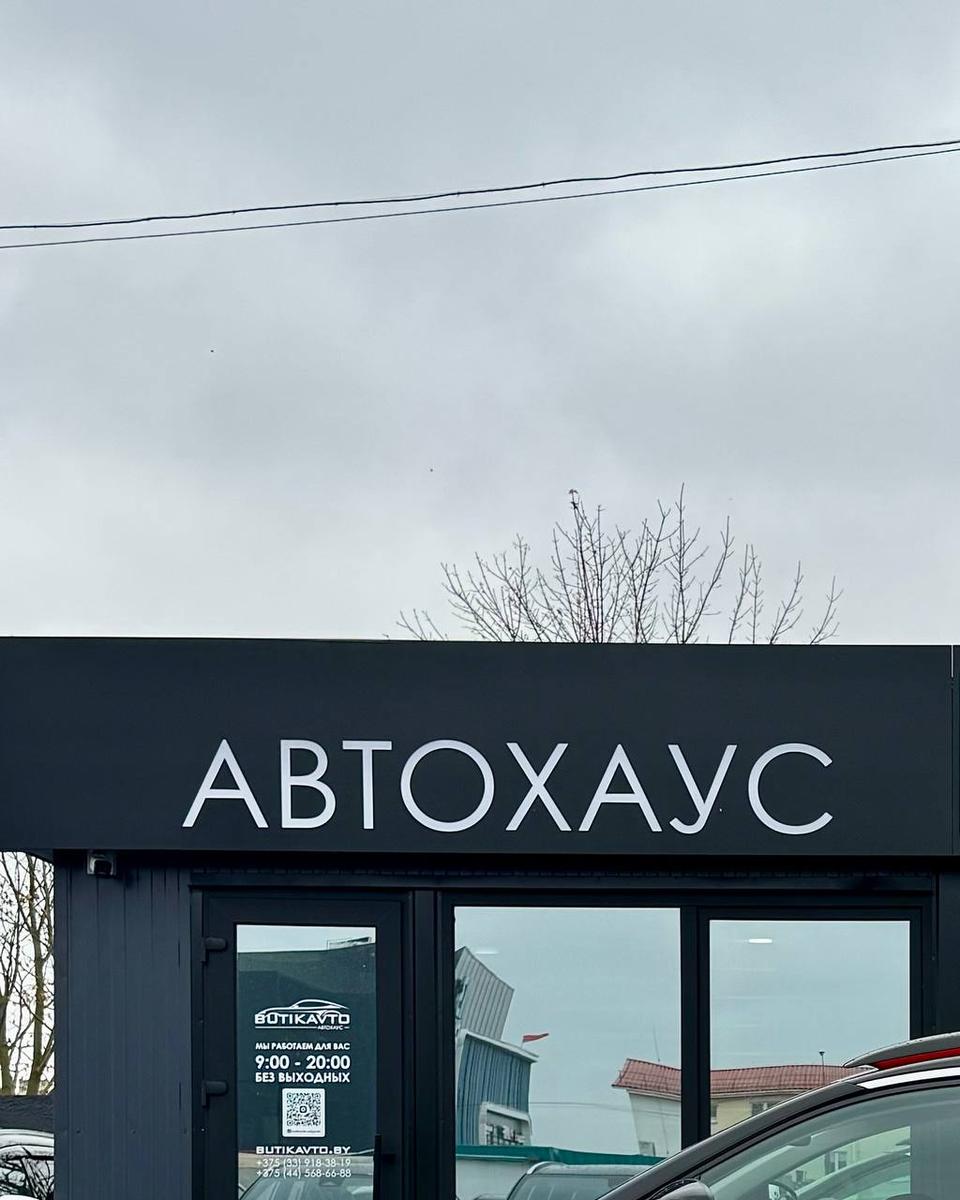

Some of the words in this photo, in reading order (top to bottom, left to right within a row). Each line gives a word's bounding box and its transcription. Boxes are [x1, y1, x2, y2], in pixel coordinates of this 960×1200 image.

[182, 739, 833, 836] АВТОХАУС
[254, 1013, 351, 1025] BUTIKAVTO
[314, 1043, 332, 1051] ДЛЯ
[255, 1055, 290, 1069] 9:00
[306, 1055, 351, 1069] 20:00
[255, 1072, 275, 1083] БЕЗ
[278, 1072, 351, 1083] ВЫХОДНЫХ
[256, 1146, 351, 1154] BUTIKAVTO.BY
[256, 1159, 281, 1167] +375
[283, 1158, 301, 1168] (33)
[304, 1158, 351, 1167] 918-38-19
[256, 1169, 281, 1177] +375
[283, 1168, 301, 1179] (44)
[304, 1169, 352, 1178] 568-66-88
